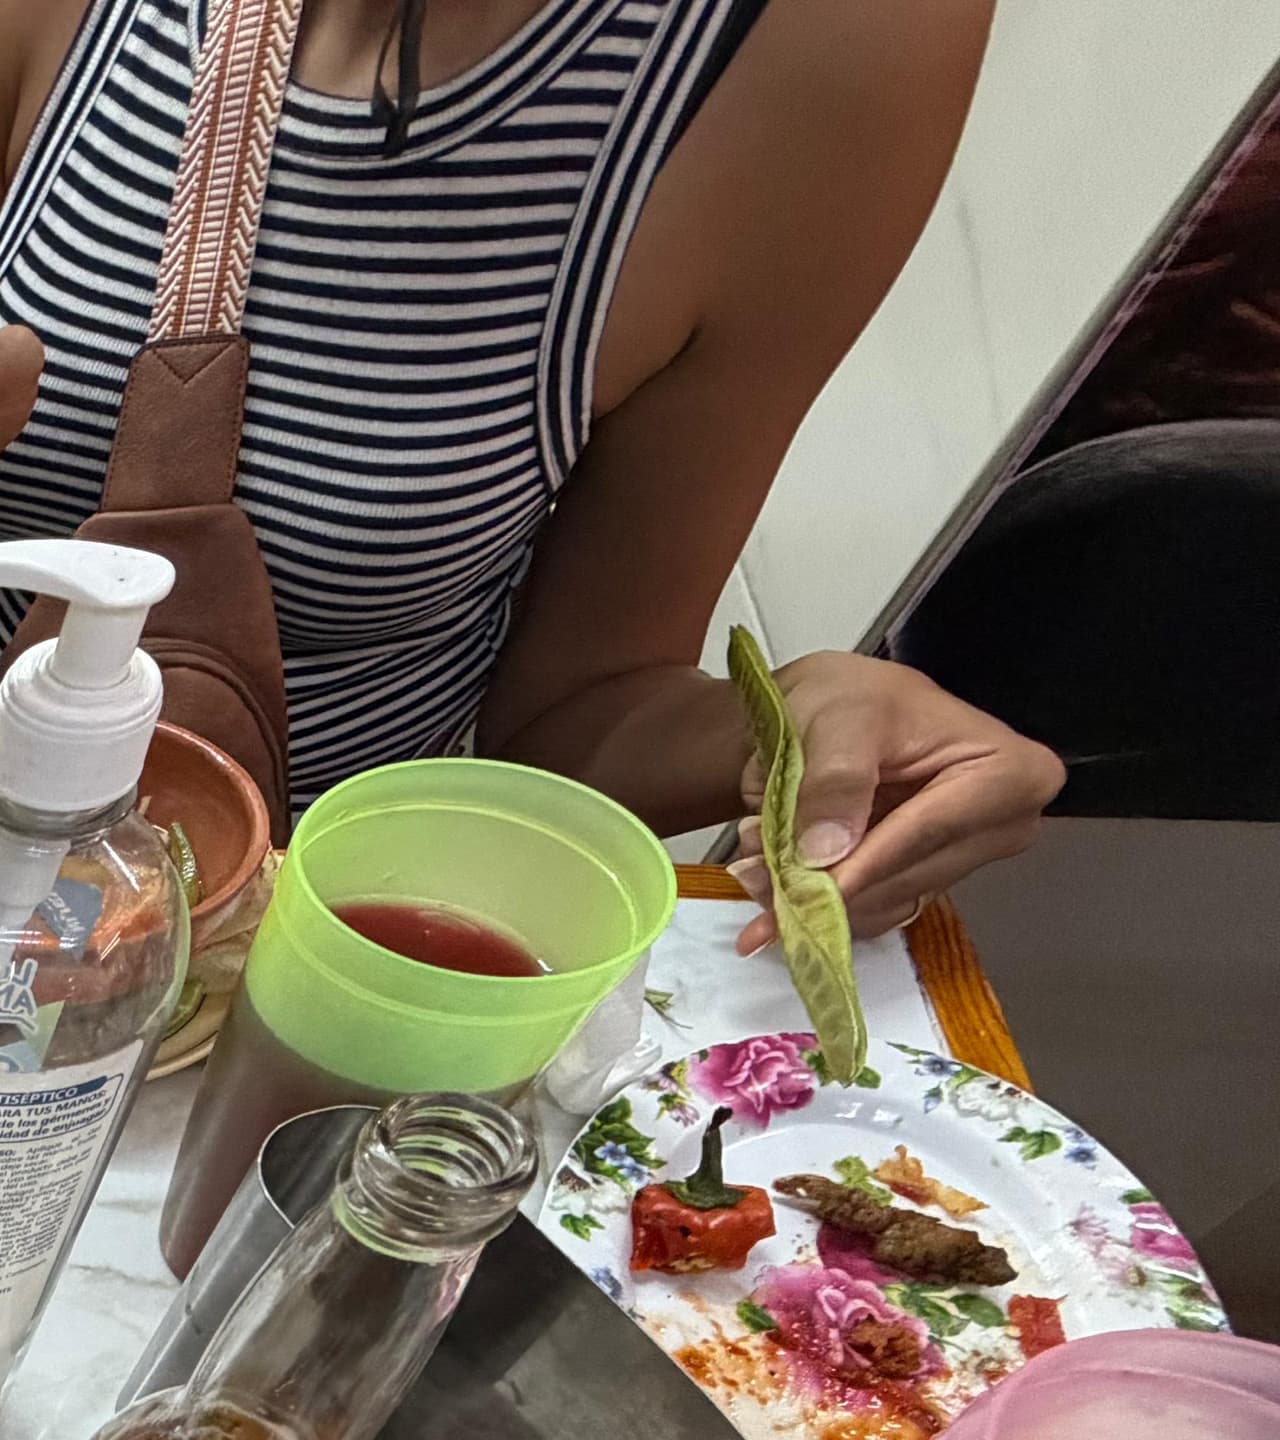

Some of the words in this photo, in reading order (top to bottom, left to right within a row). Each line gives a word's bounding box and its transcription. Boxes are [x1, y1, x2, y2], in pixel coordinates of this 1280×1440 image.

[26, 1103, 52, 1116] TUS
[18, 1116, 37, 1128] los
[32, 1123, 49, 1136] de
